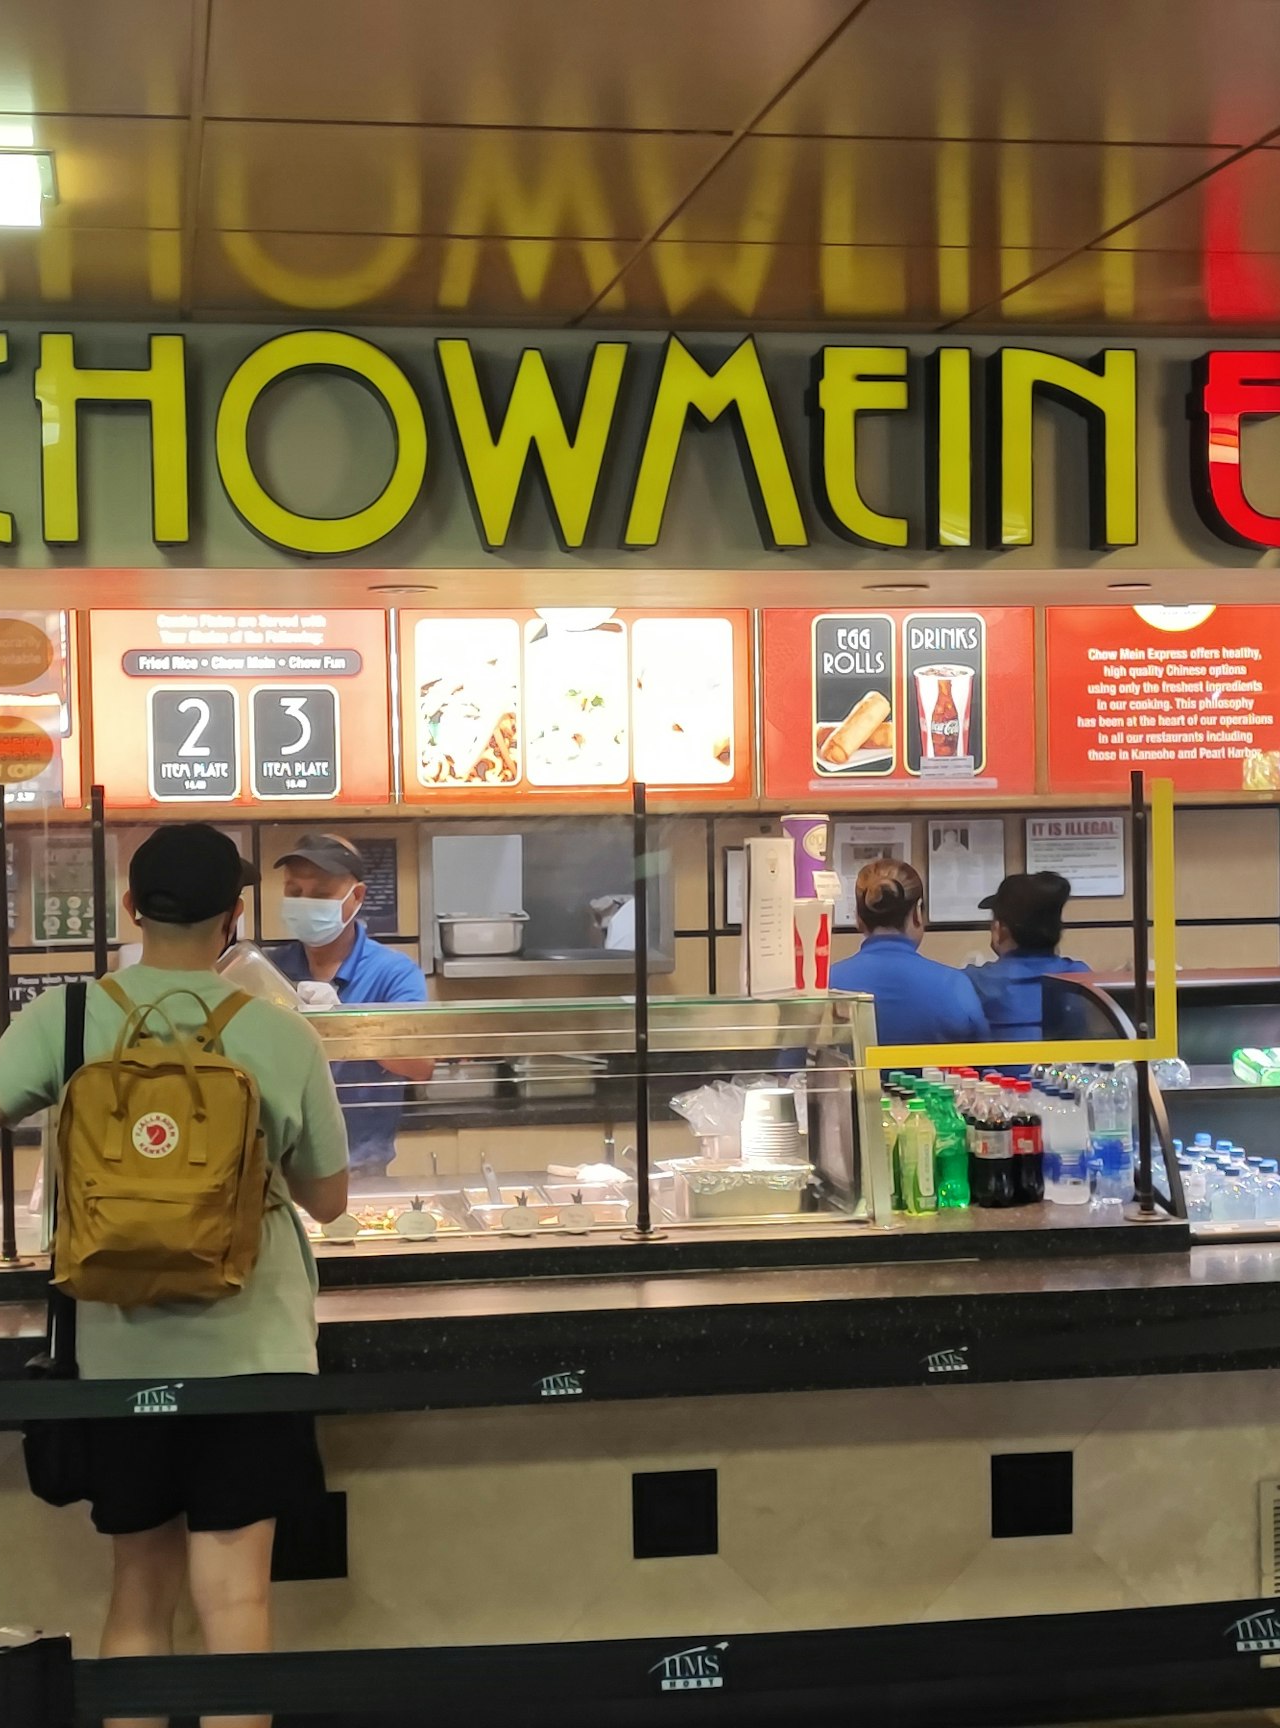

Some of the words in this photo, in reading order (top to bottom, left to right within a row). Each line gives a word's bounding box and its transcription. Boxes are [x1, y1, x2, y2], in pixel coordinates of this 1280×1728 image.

[836, 628, 870, 649] EGG
[910, 627, 978, 649] DRINKS
[1088, 648, 1117, 660] Chow
[1120, 648, 1145, 659] Mein
[1147, 648, 1188, 661] Express
[1190, 648, 1220, 659] offers
[1222, 647, 1262, 660] healthy,
[138, 656, 169, 670] Fried
[172, 656, 198, 670] Rice
[211, 656, 245, 670] Chow
[247, 656, 275, 670] Mein
[288, 656, 321, 670] Chow
[324, 656, 345, 670] Fun
[822, 651, 886, 674] ROLLS
[1103, 665, 1126, 678] high
[1129, 665, 1164, 678] quality
[1166, 664, 1207, 675] Chinese
[1209, 664, 1247, 677] options
[1088, 683, 1116, 695] using
[1119, 682, 1141, 695] only
[1143, 682, 1159, 693] the
[1161, 681, 1204, 693] freshest
[1206, 680, 1263, 694] ingredients
[1097, 700, 1107, 711] in
[1109, 701, 1127, 711] our
[1129, 699, 1172, 712] cooking.
[1174, 698, 1196, 710] This
[1198, 697, 1254, 712] philosophy
[178, 698, 210, 757] 2
[279, 697, 312, 755] 3
[1077, 717, 1096, 727] has
[1098, 715, 1124, 727] been
[1126, 716, 1137, 727] at
[1139, 715, 1156, 727] the
[1158, 715, 1185, 727] heart
[1187, 714, 1198, 726] of
[1200, 716, 1217, 726] our
[1219, 713, 1273, 728] operations
[1098, 733, 1108, 744] in
[1111, 733, 1124, 743] all
[1126, 734, 1144, 743] our
[1145, 731, 1204, 743] restaurants
[1206, 730, 1253, 744] including
[1087, 749, 1116, 760] those
[1118, 749, 1129, 760] in
[1178, 748, 1197, 759] and
[1199, 747, 1226, 759] Pearl
[161, 763, 191, 778] ITEM
[193, 762, 228, 778] PLATE
[263, 762, 291, 778] ITEM
[294, 762, 329, 777] PLATE
[1032, 823, 1045, 836] IT
[1048, 822, 1062, 836] IS
[1065, 821, 1118, 836] ILLEGAL
